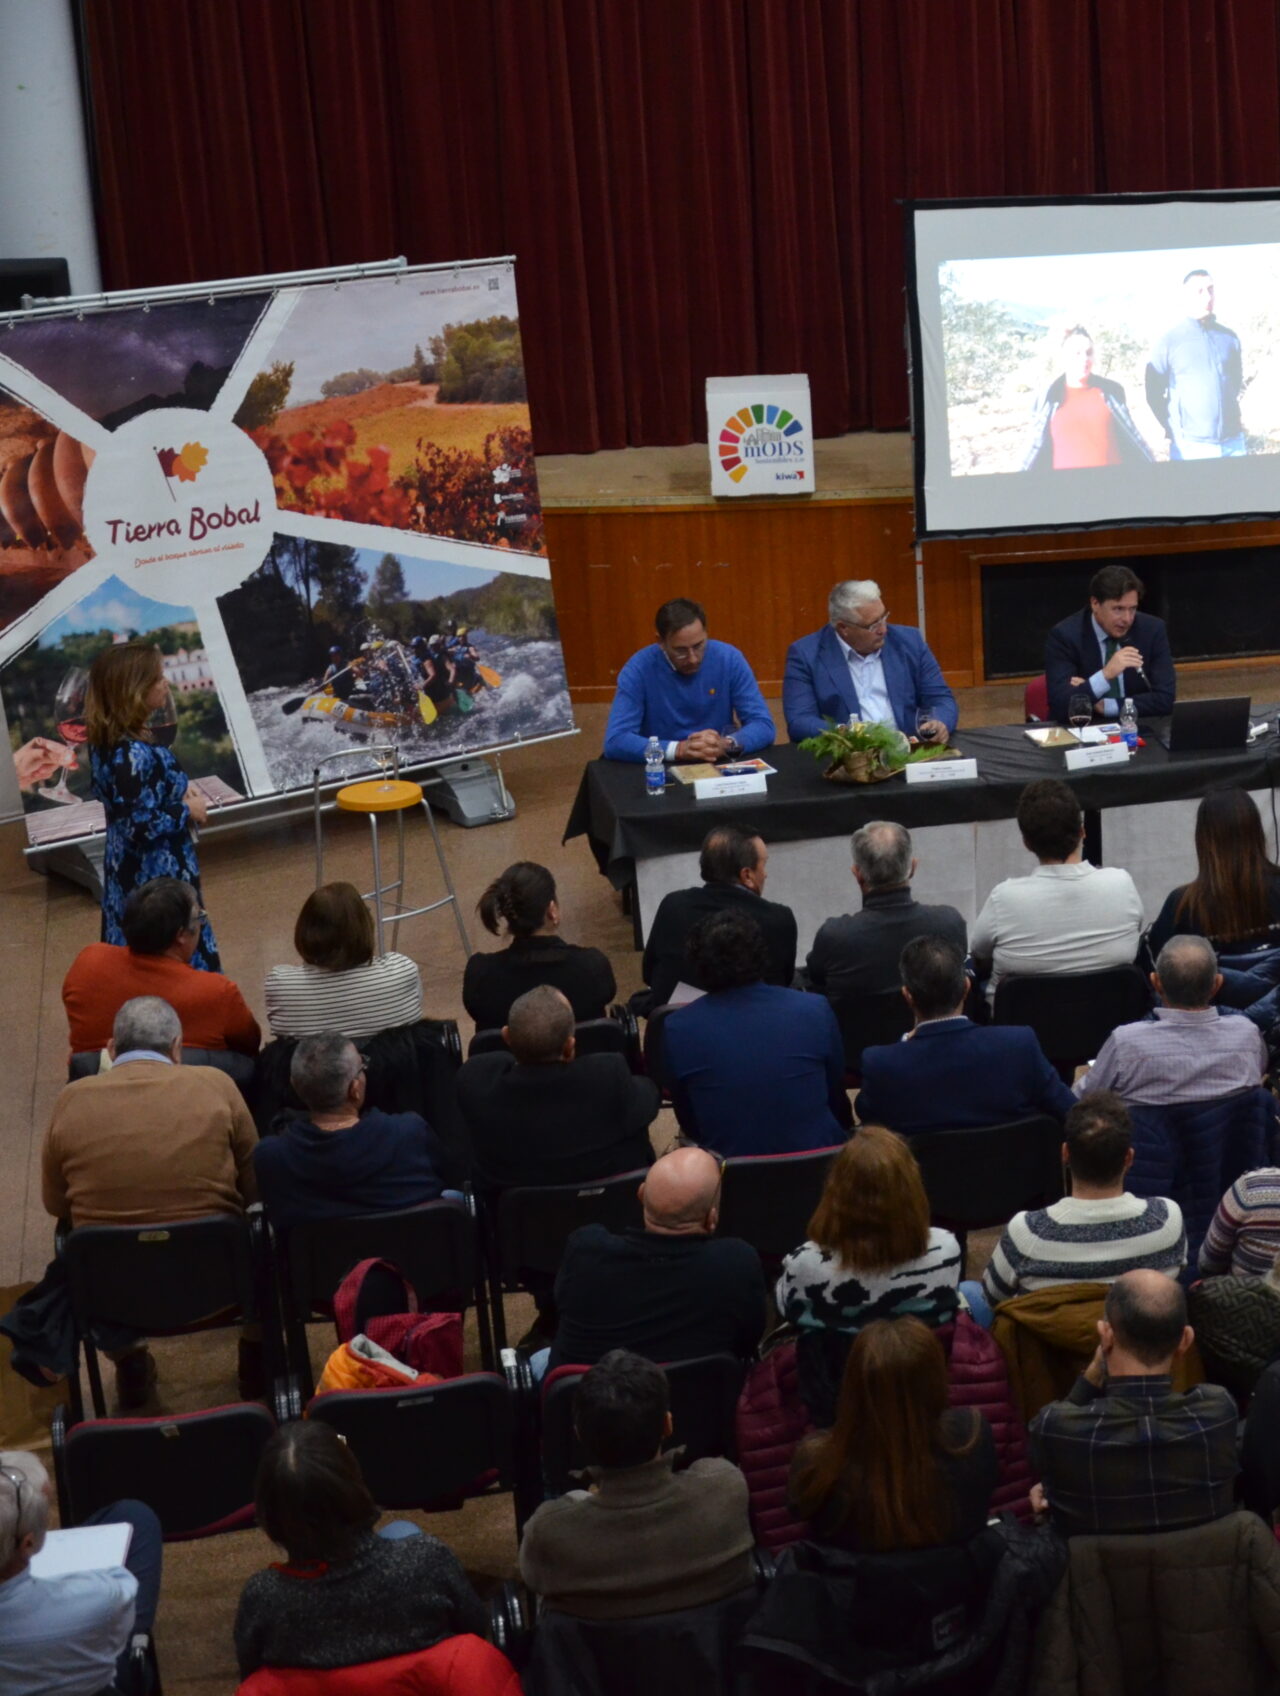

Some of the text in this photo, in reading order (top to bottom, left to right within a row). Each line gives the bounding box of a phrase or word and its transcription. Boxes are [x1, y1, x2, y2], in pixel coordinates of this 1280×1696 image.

[744, 440, 804, 457] mODS
[775, 472, 798, 480] kiwa
[105, 498, 261, 546] Tierra Bobal
